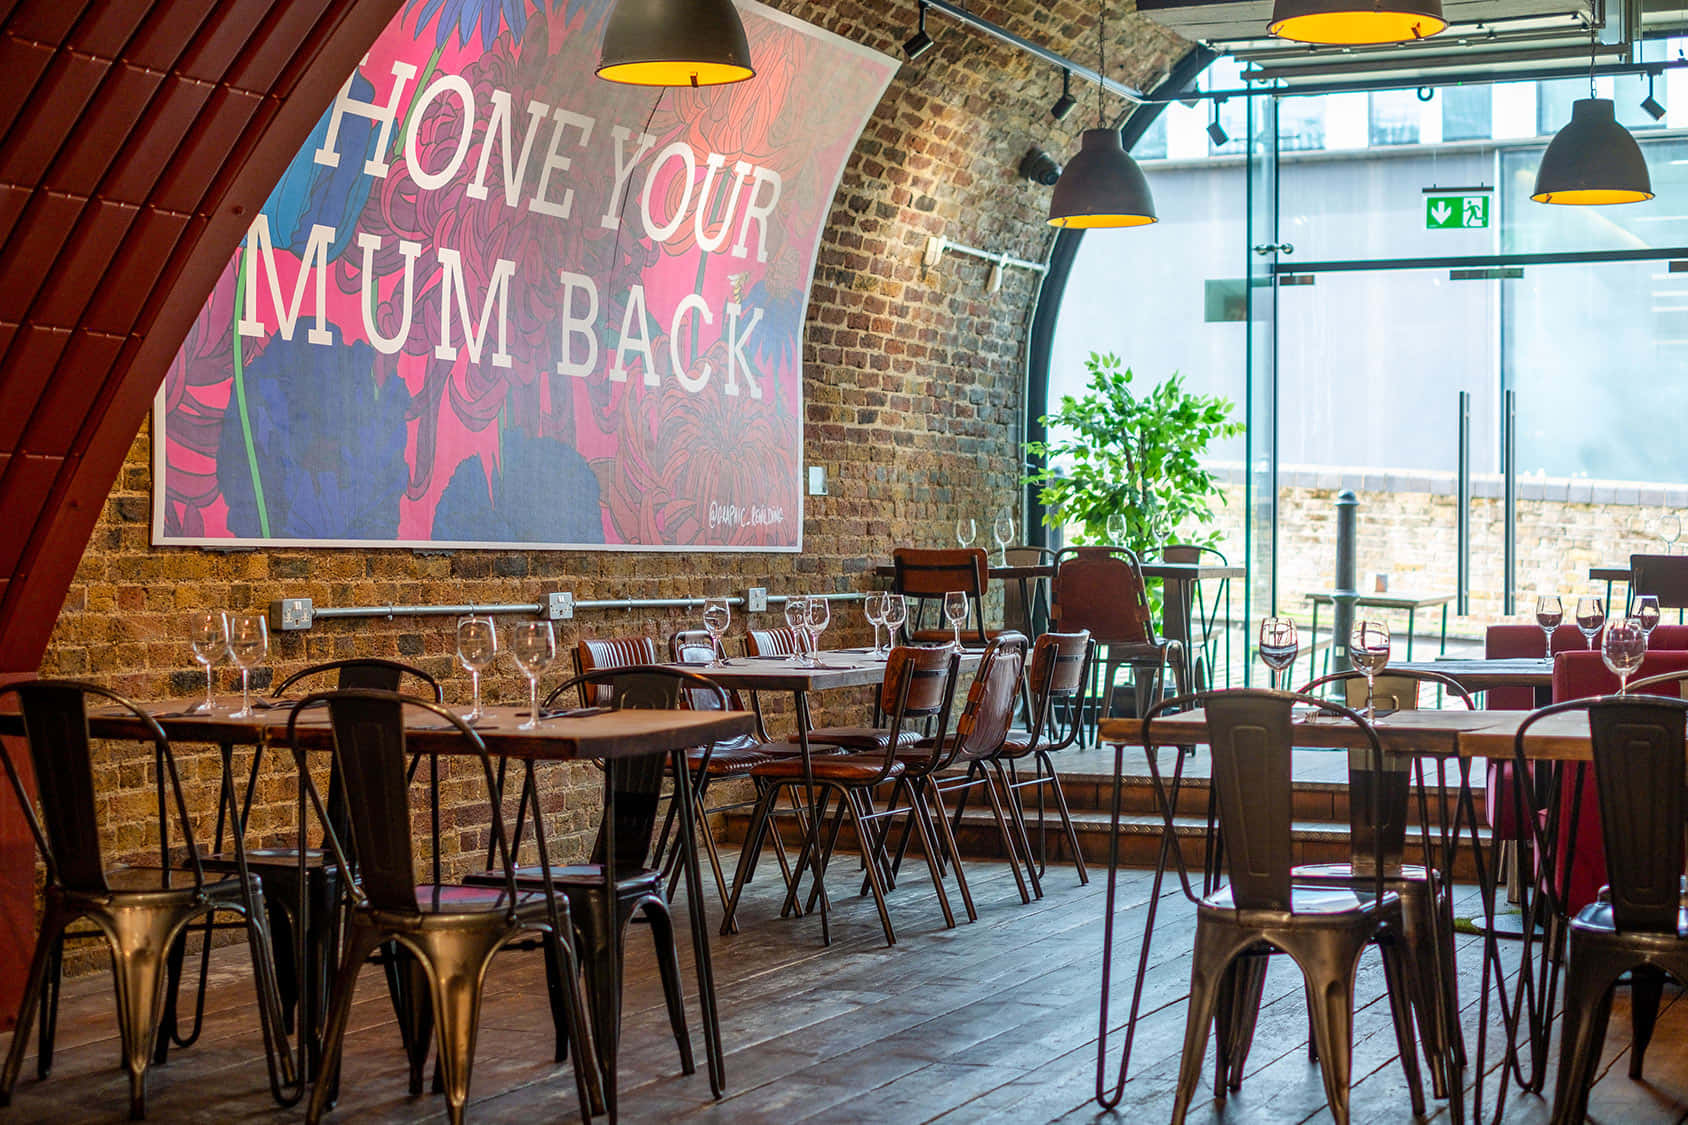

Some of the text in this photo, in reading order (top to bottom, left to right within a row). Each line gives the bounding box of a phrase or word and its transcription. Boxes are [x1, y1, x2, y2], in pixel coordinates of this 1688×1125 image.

[601, 124, 782, 263] YOUR
[238, 213, 764, 398] MUM BACK
